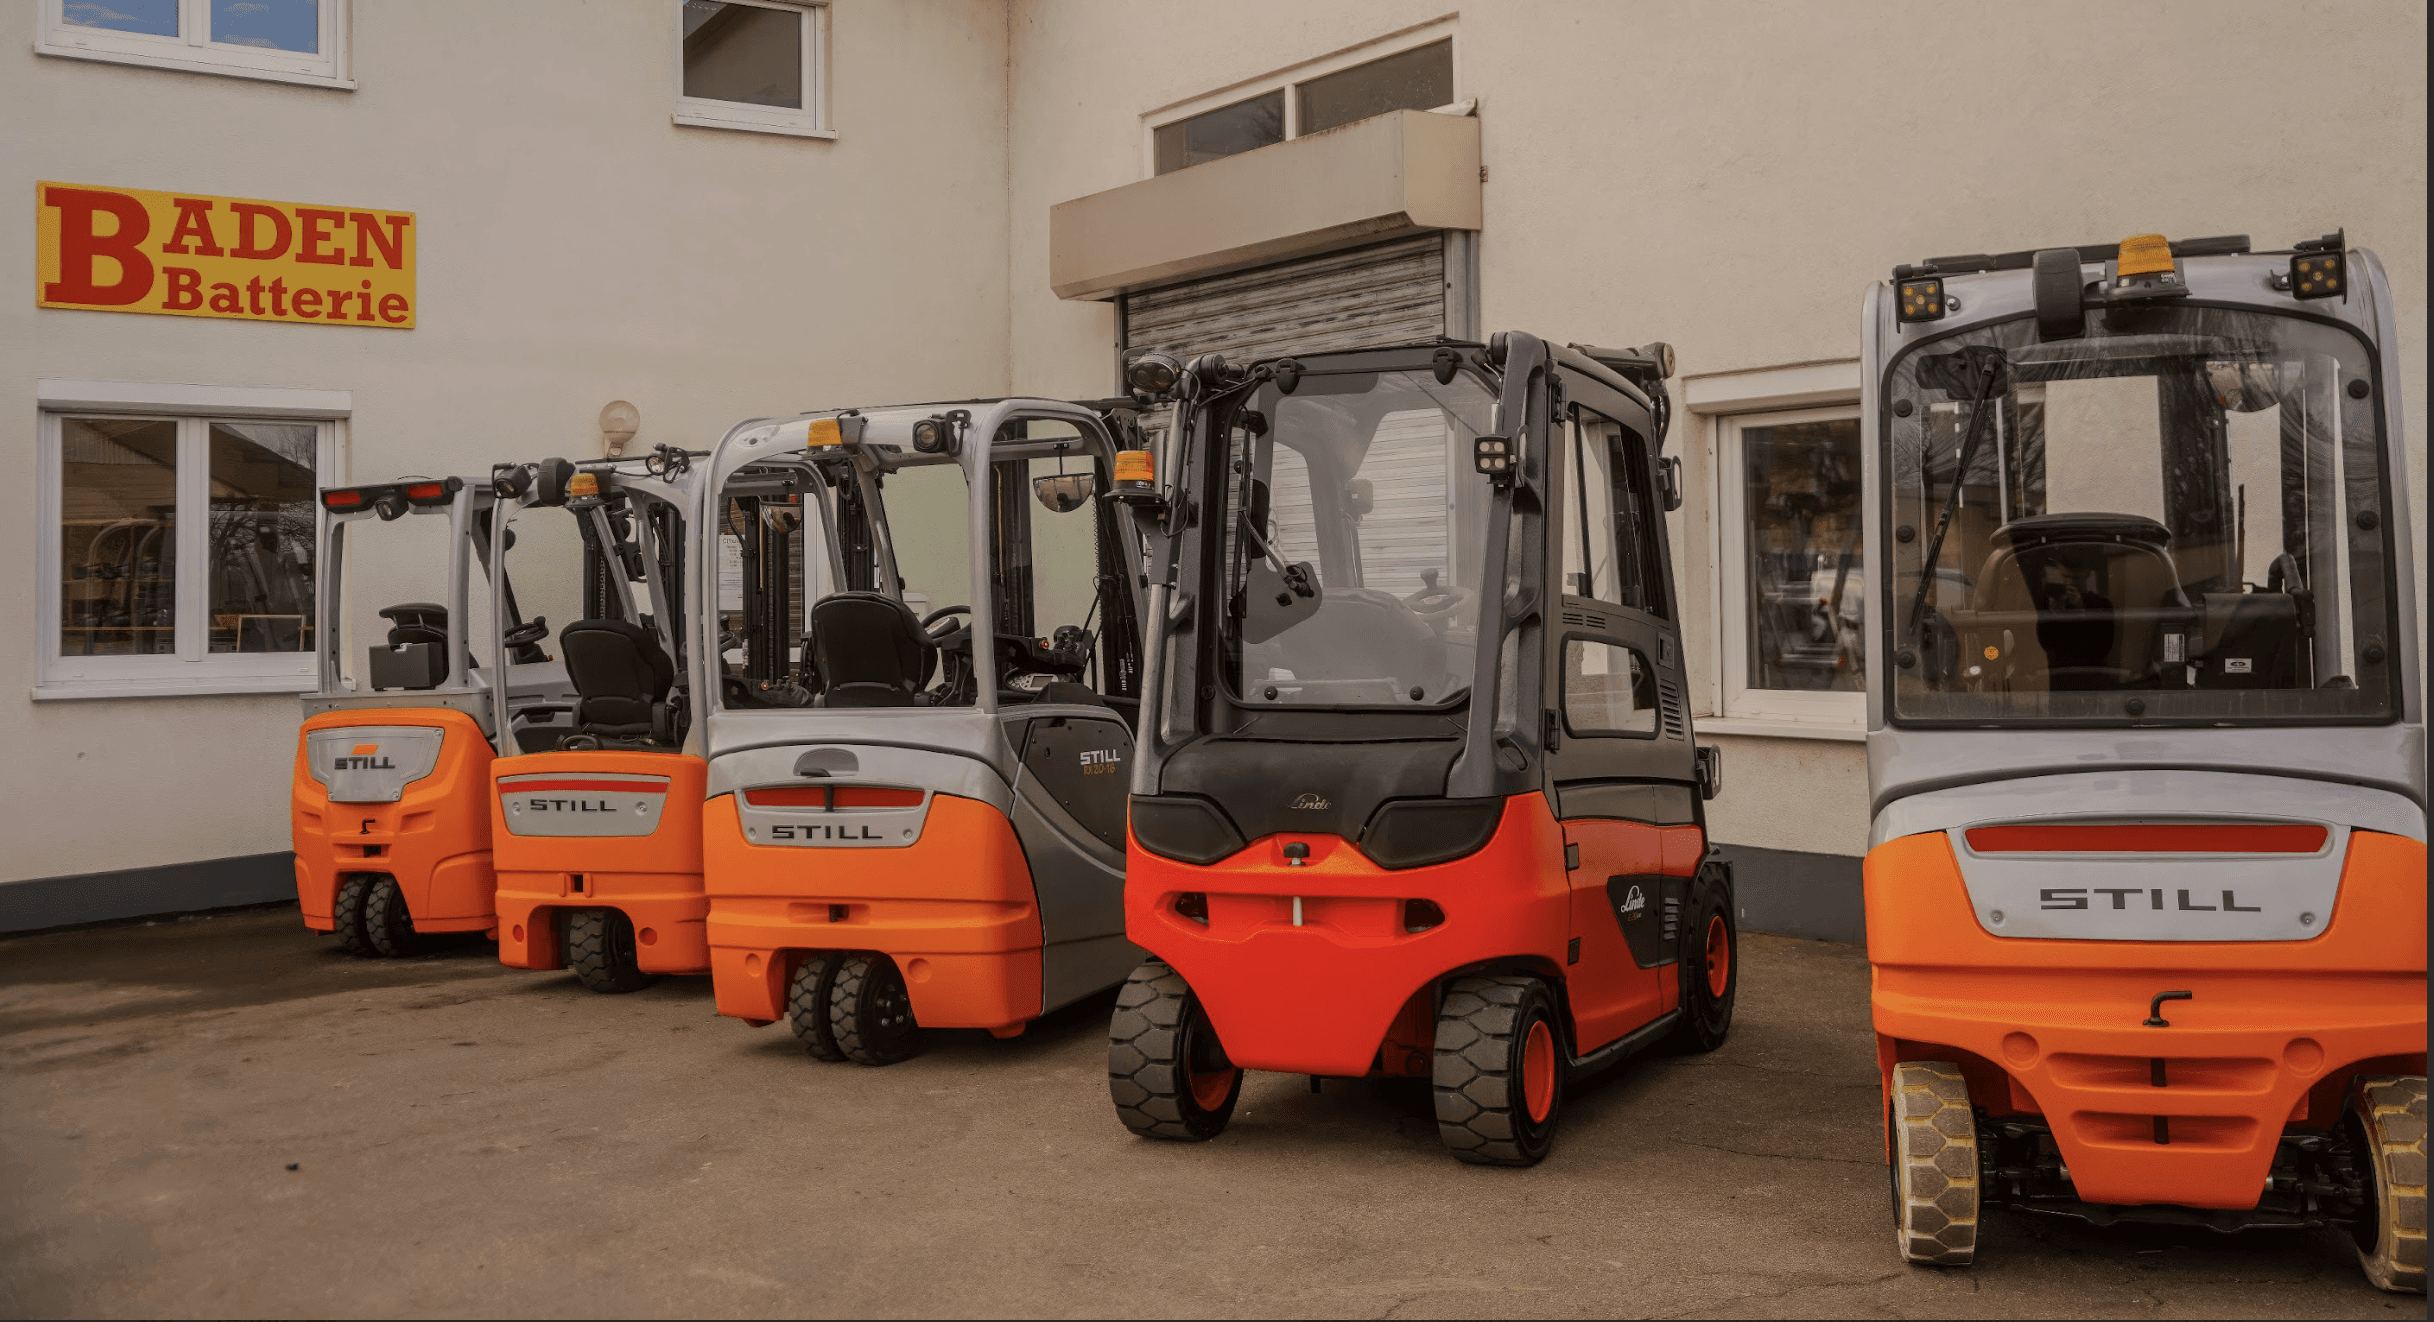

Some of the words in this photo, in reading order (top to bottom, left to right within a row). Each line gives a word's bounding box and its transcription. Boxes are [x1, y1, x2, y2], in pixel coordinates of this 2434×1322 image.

[44, 186, 411, 306] BADEN
[162, 266, 410, 324] Batterie
[334, 756, 396, 770] STILL
[1080, 748, 1121, 766] STILL
[530, 798, 617, 812] STILL
[1286, 792, 1332, 810] Linde
[771, 824, 883, 840] STILL
[1620, 885, 1646, 913] Linde
[2040, 887, 2262, 913] STILL
